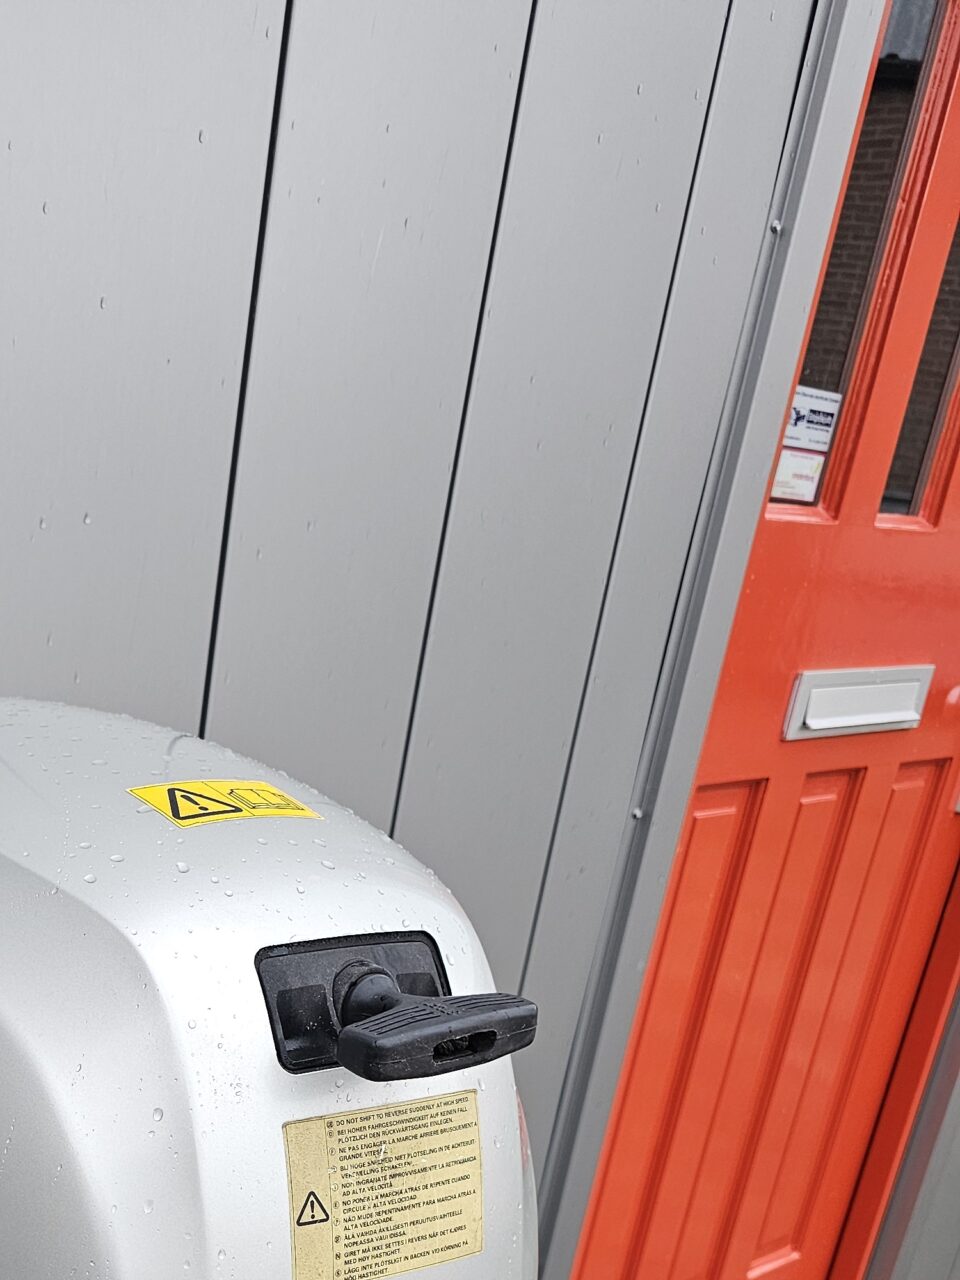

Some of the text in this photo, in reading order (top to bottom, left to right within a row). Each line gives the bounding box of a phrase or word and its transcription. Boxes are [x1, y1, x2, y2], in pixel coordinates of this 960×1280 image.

[359, 1114, 375, 1122] SHIFT
[384, 1108, 408, 1118] REVERSE
[409, 1103, 434, 1113] SUDDENLY
[343, 1223, 358, 1231] ALTA
